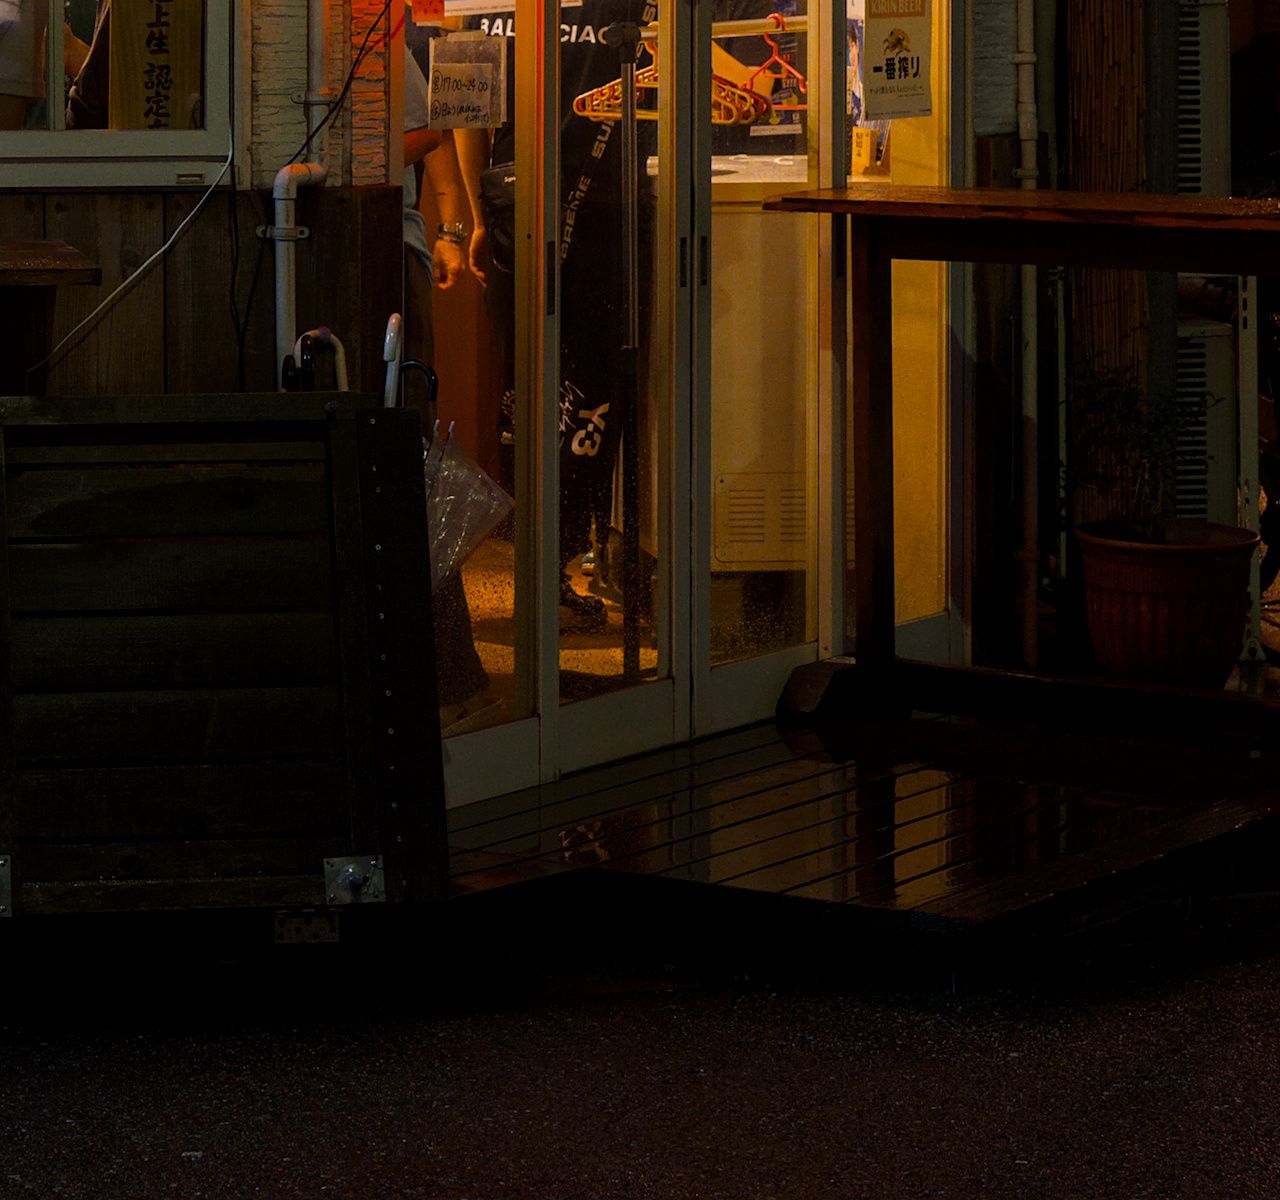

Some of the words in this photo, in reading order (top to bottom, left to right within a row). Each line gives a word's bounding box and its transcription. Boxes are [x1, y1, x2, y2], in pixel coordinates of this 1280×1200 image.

[871, 1, 898, 15] KIRIN
[872, 55, 920, 81] 一番搾り
[560, 175, 592, 263] PREME
[570, 401, 610, 457] Y-3
